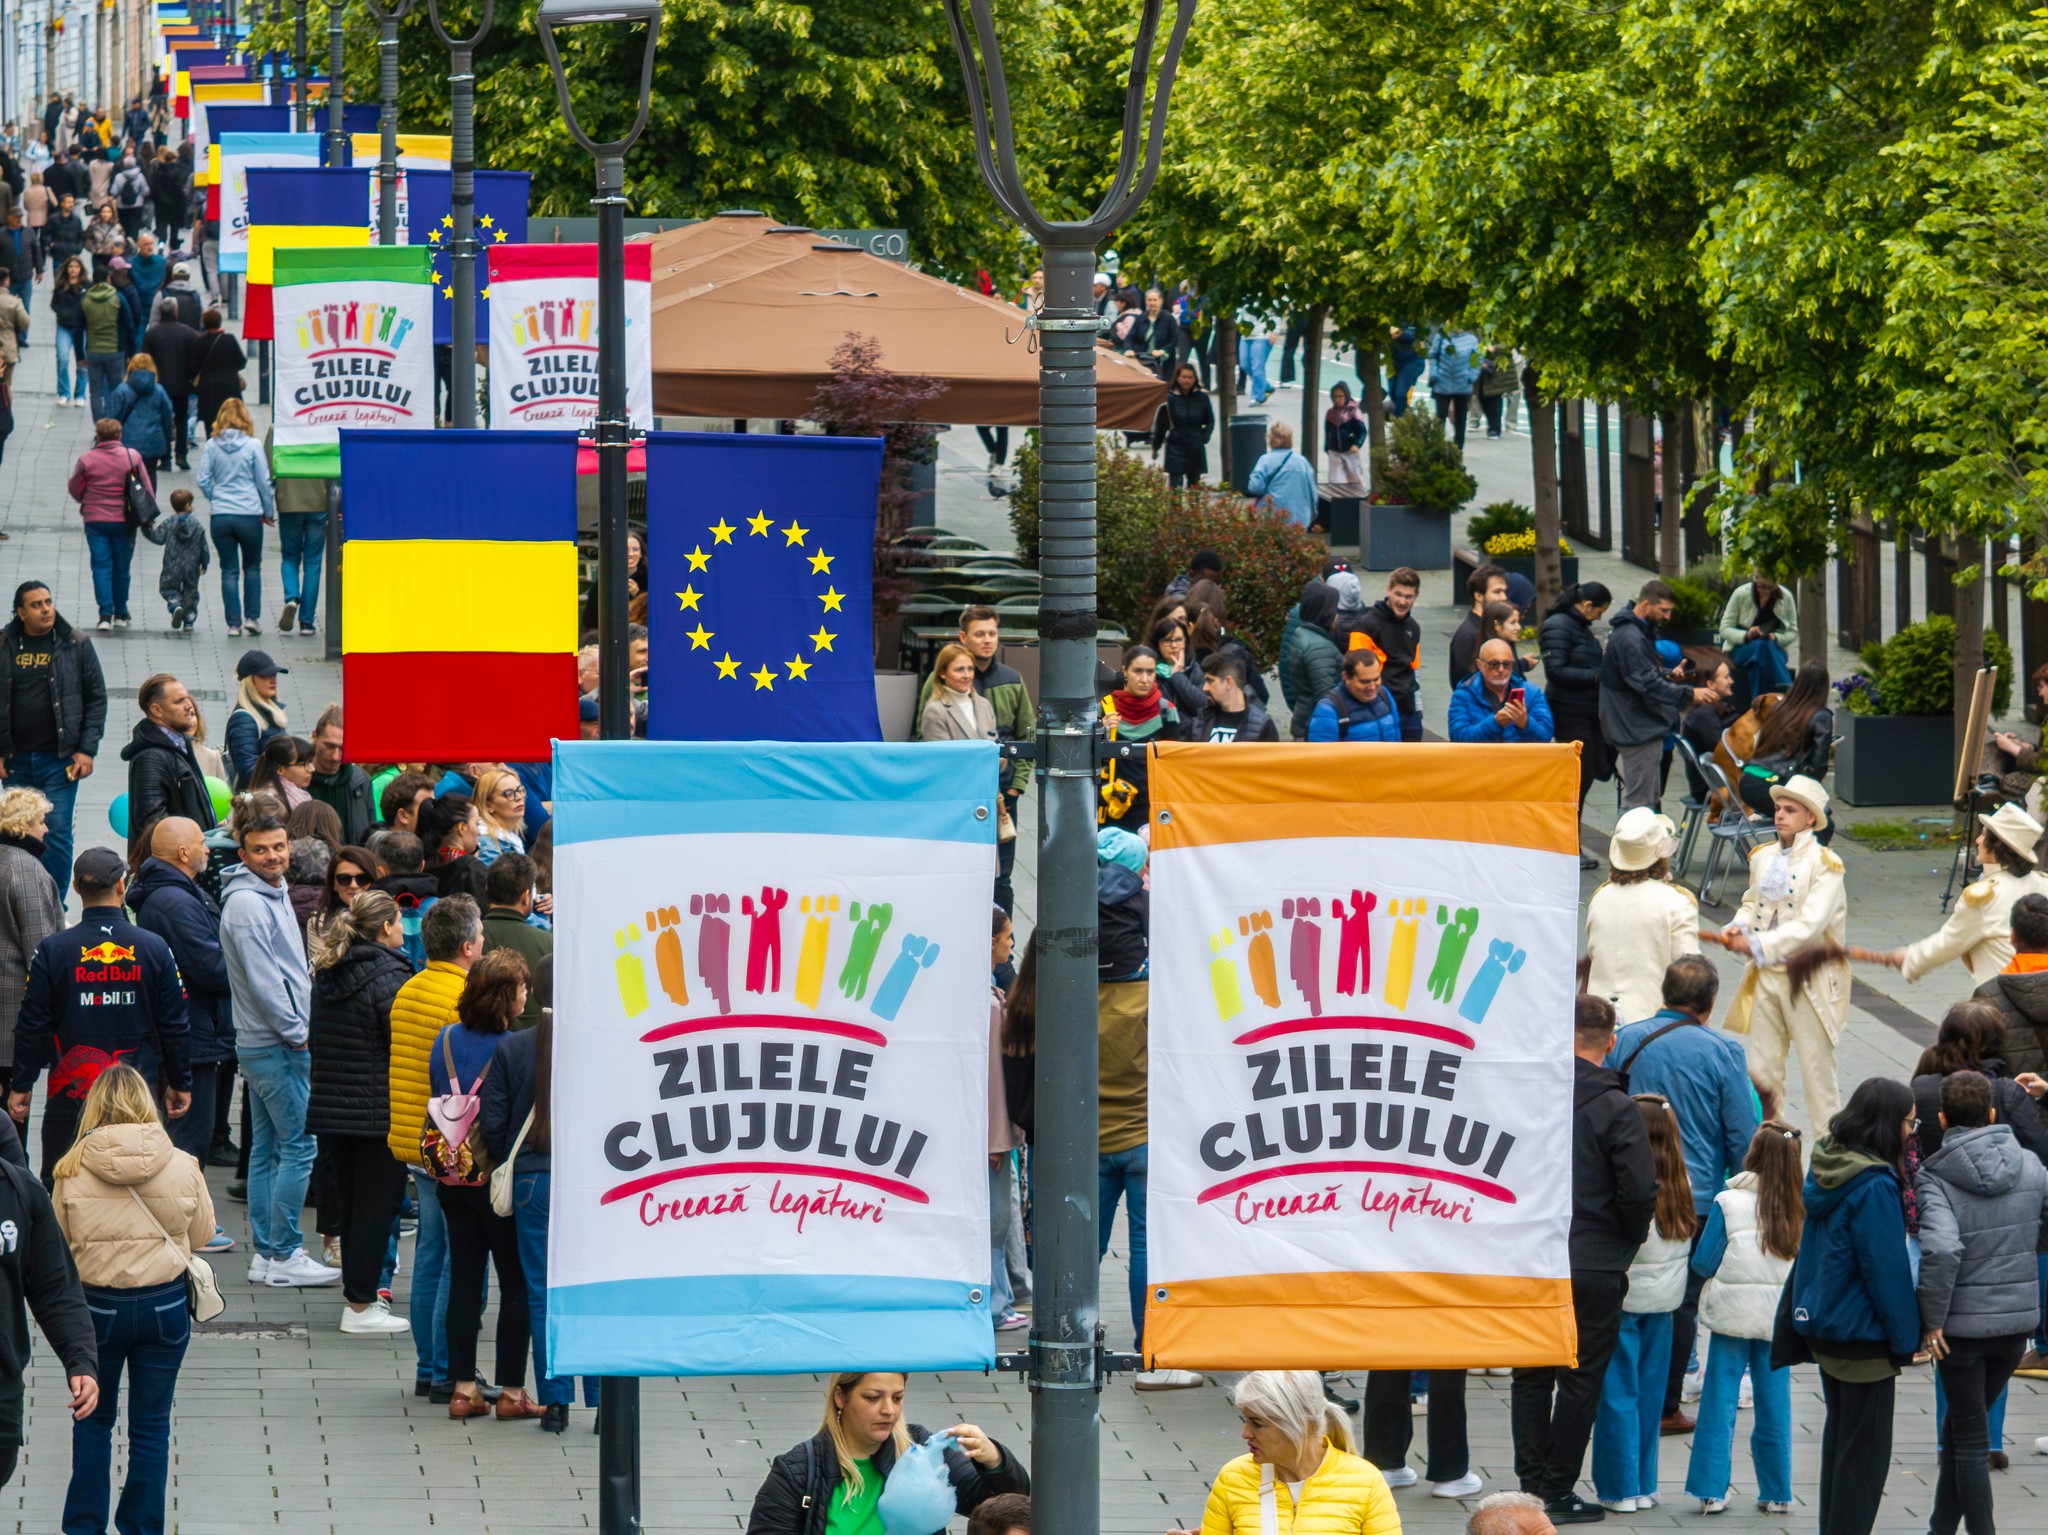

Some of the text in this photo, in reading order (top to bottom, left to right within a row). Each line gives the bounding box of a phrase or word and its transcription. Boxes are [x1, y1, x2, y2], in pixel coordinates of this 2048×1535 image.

[869, 234, 905, 256] GO
[311, 357, 392, 379] ZILELE
[527, 354, 600, 377] ZILEL
[294, 379, 412, 408] CLUJULUI
[509, 376, 629, 403] CLUJUL
[75, 965, 142, 983] Red Bull
[80, 991, 120, 1006] Mobil
[653, 1042, 874, 1100] ZILELE
[1246, 1043, 1462, 1101] ZILELE
[604, 1102, 928, 1179] CLUJULUI
[1199, 1102, 1516, 1179] CLUJULUI
[639, 1179, 886, 1234] Creează legături
[1235, 1178, 1475, 1232] Creează legături
